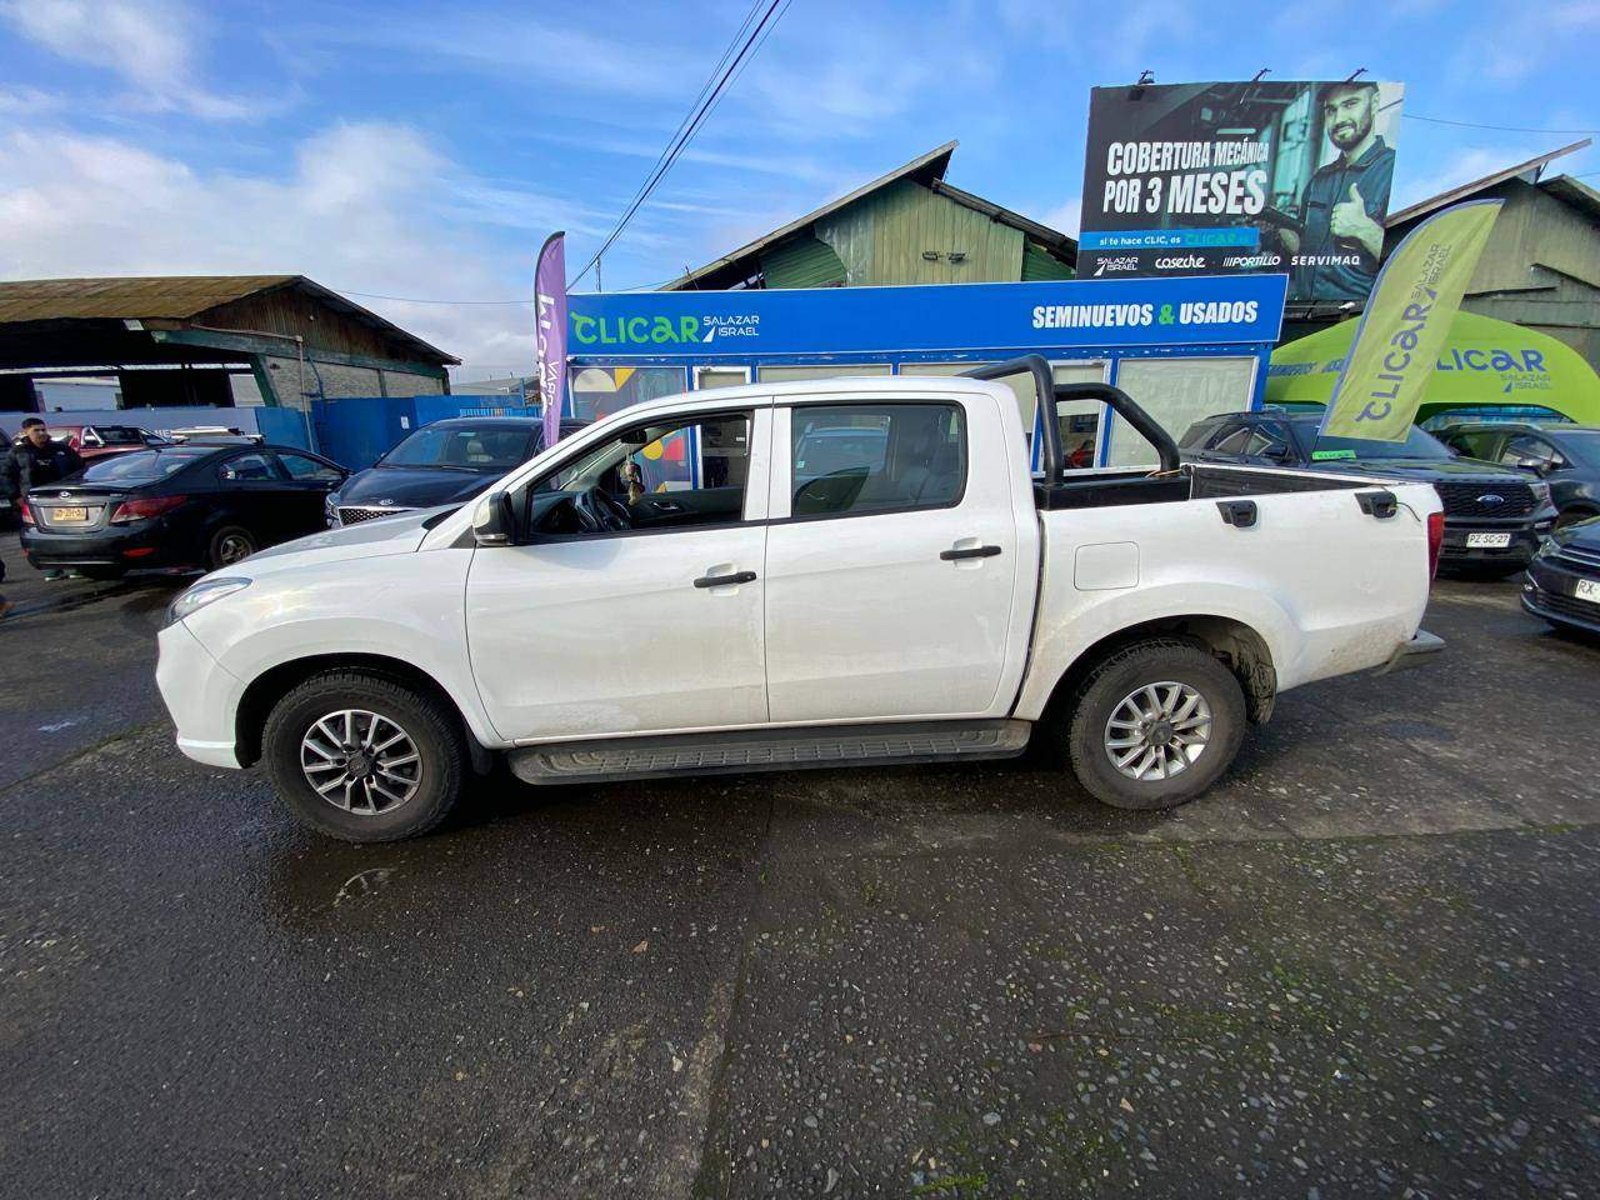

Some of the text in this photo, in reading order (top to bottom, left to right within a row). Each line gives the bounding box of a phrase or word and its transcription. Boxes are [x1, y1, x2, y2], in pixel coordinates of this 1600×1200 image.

[1107, 137, 1269, 176] COBERTURA MECÁNICA
[1103, 169, 1268, 215] POR 3 MESES
[1120, 236, 1142, 245] hace
[1291, 256, 1360, 266] SERVIMAQ
[1032, 301, 1258, 328] SEMINUEVOS & USADOS
[703, 315, 760, 326] SALAZAR
[718, 327, 760, 337] ISRAEL
